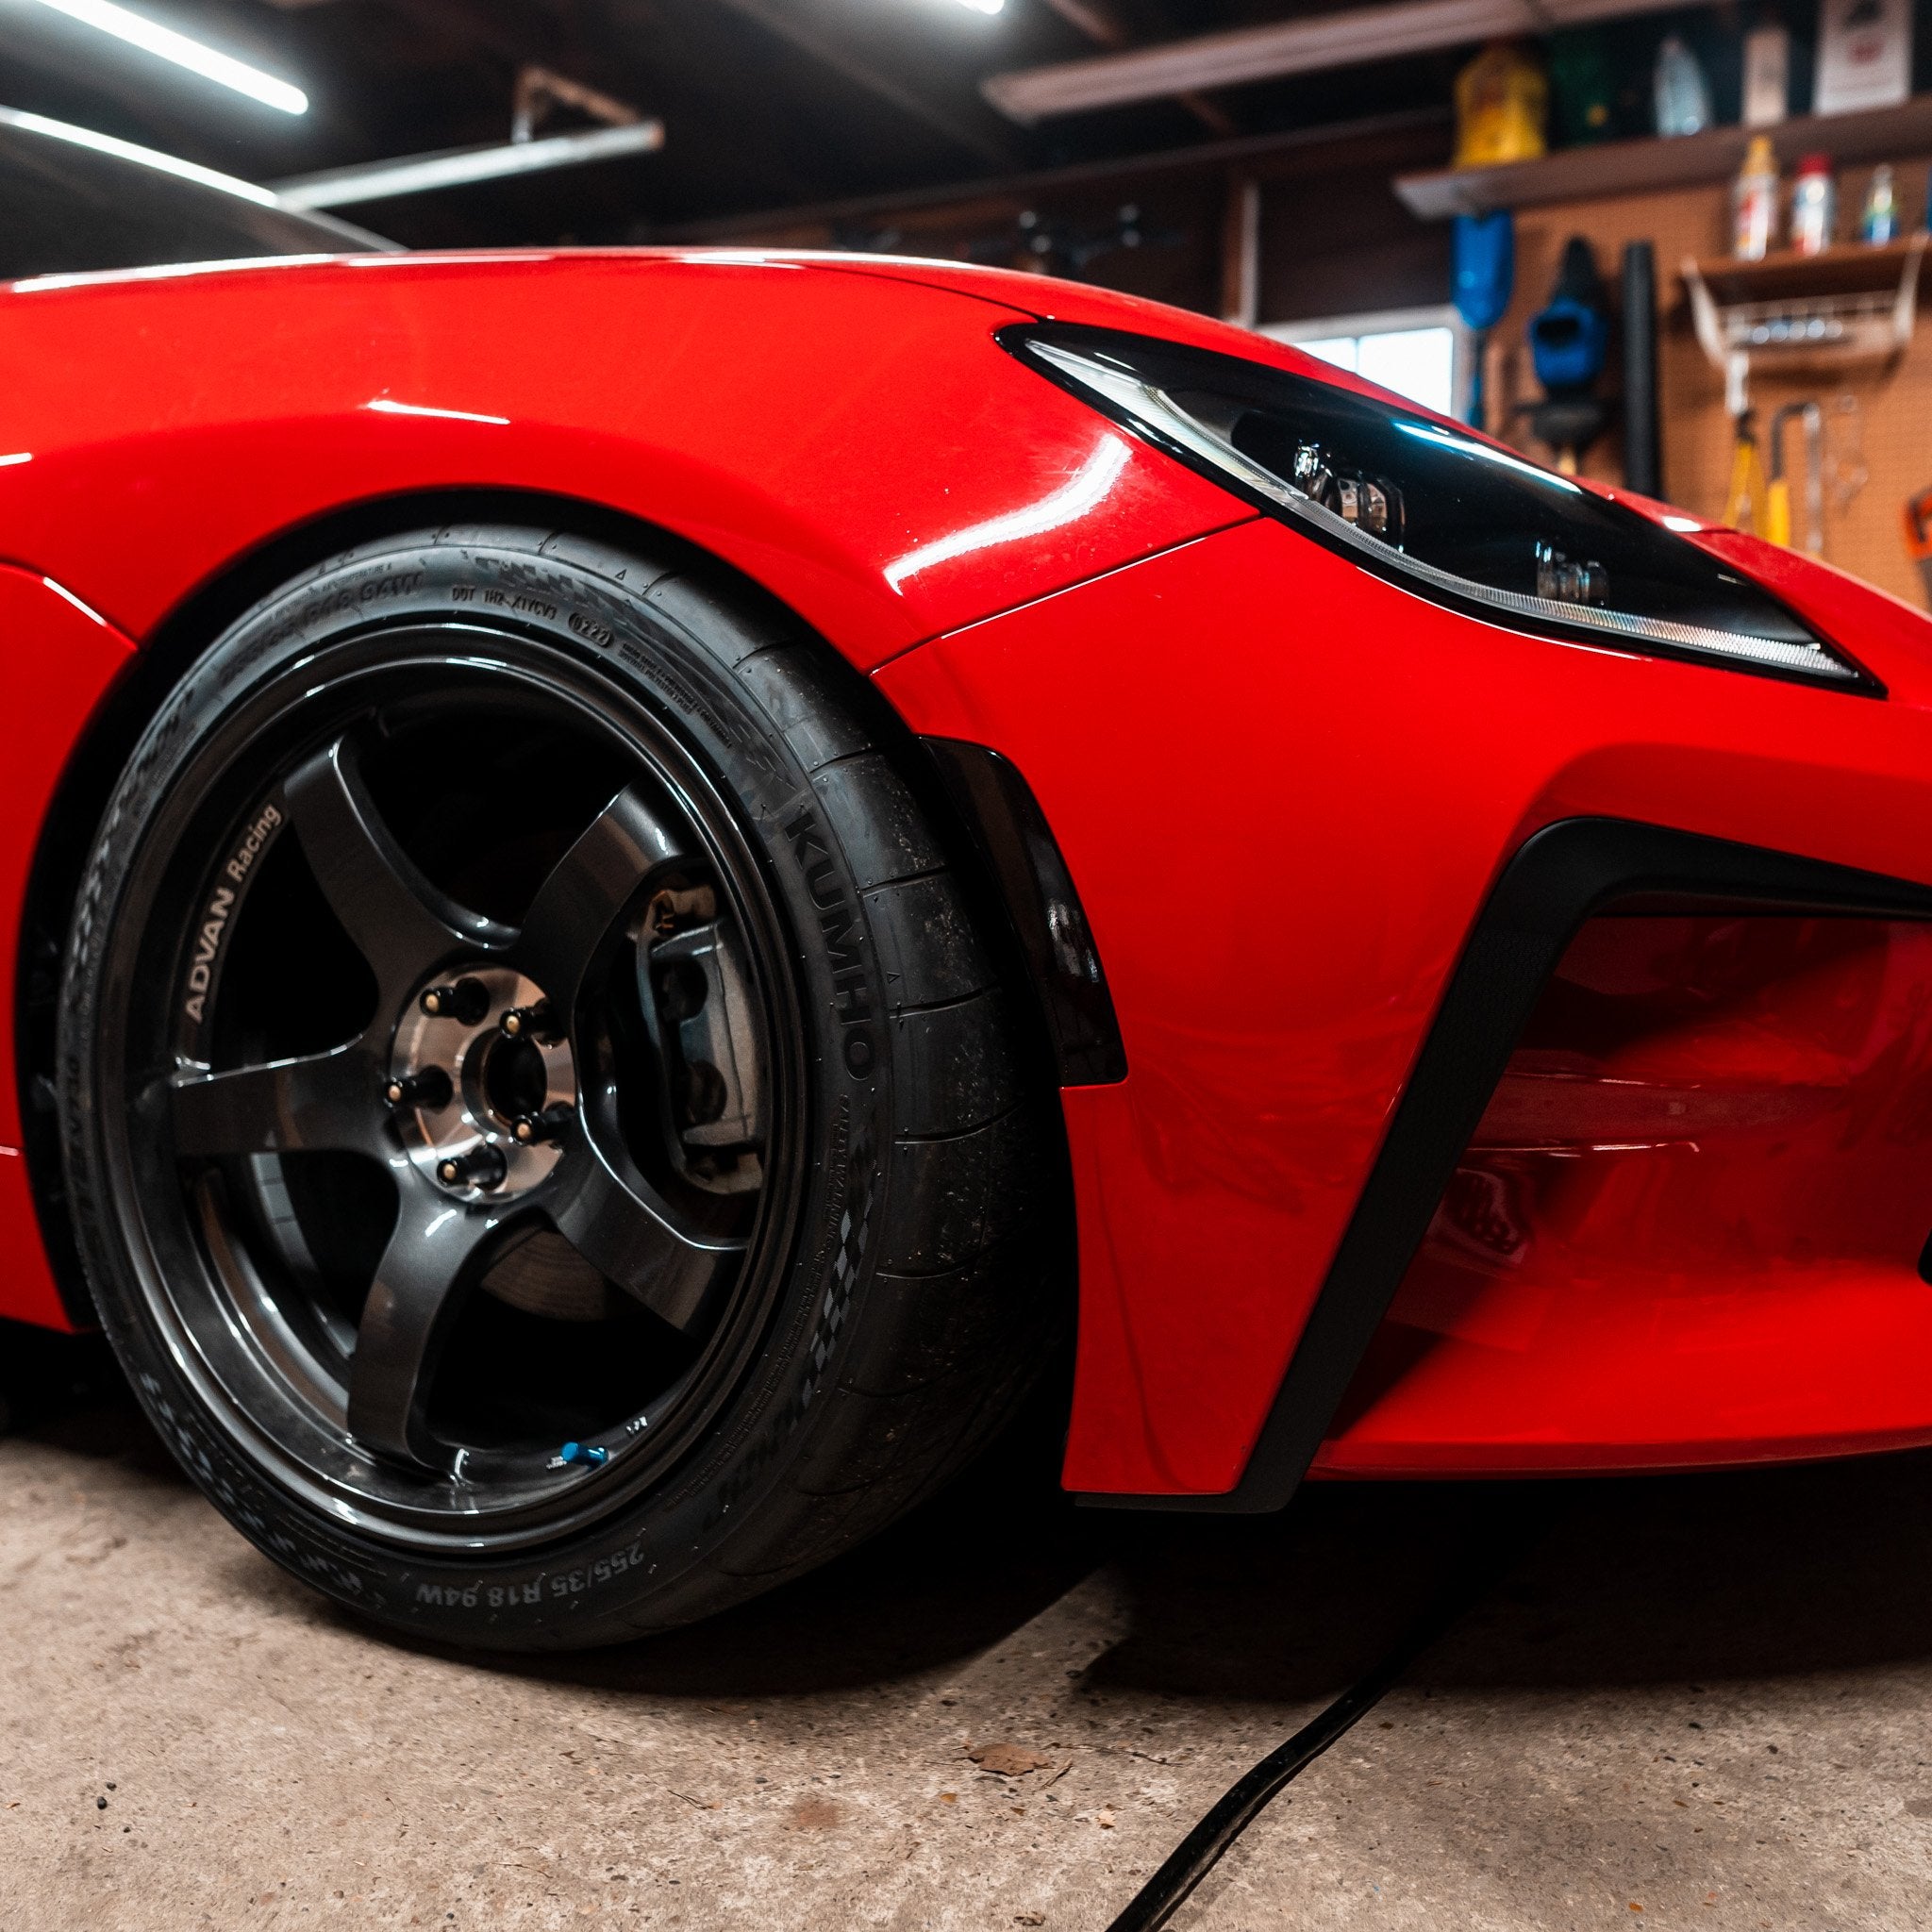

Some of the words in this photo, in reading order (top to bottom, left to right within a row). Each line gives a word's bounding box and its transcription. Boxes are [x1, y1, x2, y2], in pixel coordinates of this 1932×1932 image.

[452, 586, 476, 602] DOT
[186, 887, 235, 1024] ADVAN
[226, 804, 282, 883] Racing
[784, 811, 874, 1081] KUMHO
[551, 1541, 644, 1597] 255/35
[416, 1583, 477, 1607] 94W
[487, 1581, 542, 1607] R18
